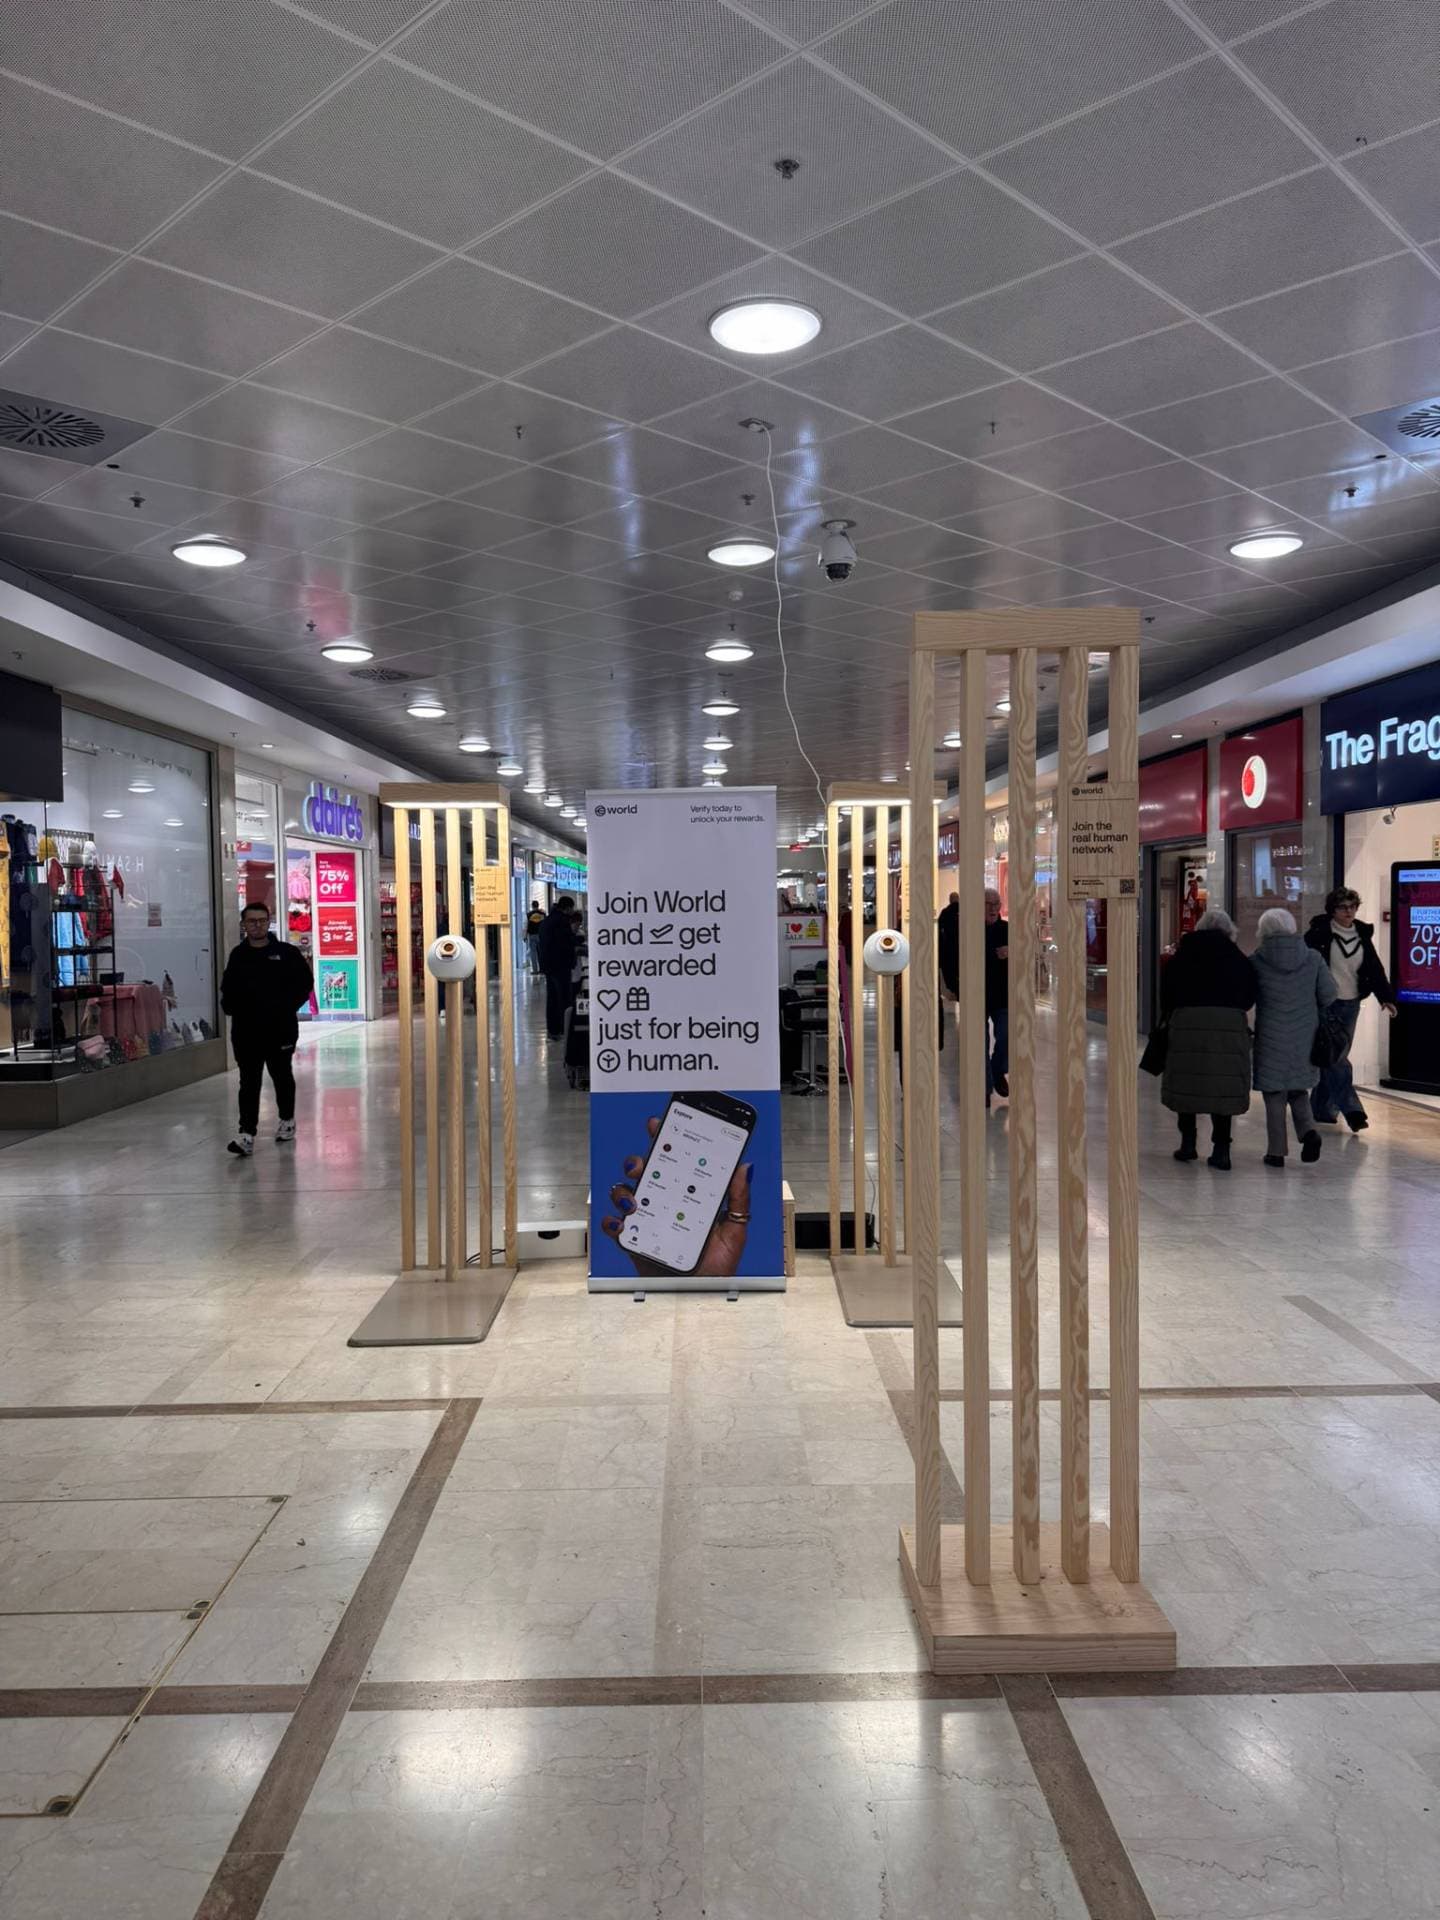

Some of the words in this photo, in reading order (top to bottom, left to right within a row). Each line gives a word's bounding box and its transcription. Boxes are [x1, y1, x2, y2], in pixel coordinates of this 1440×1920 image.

[1325, 730, 1375, 770] The
[1380, 714, 1440, 760] Frag
[1080, 787, 1103, 795] world
[607, 804, 638, 815] world
[690, 805, 711, 814] Verify
[711, 805, 733, 813] today
[690, 815, 714, 823] unlock
[716, 816, 732, 824] your
[1072, 821, 1094, 832] Join
[1096, 821, 1112, 831] the
[1072, 832, 1091, 843] real
[1093, 833, 1128, 843] human
[1072, 845, 1114, 855] network
[319, 869, 349, 882] 75%
[320, 882, 344, 895] Off
[597, 891, 648, 915] Join
[654, 889, 726, 914] World
[322, 931, 331, 943] 3
[333, 932, 344, 941] for
[345, 931, 354, 942] 2
[597, 922, 644, 946] and
[679, 923, 721, 951] get
[1410, 945, 1440, 966] OF
[597, 952, 717, 977] rewarded
[597, 1018, 642, 1046] just
[648, 1016, 682, 1040] for
[688, 1015, 760, 1044] being
[627, 1048, 719, 1072] human.
